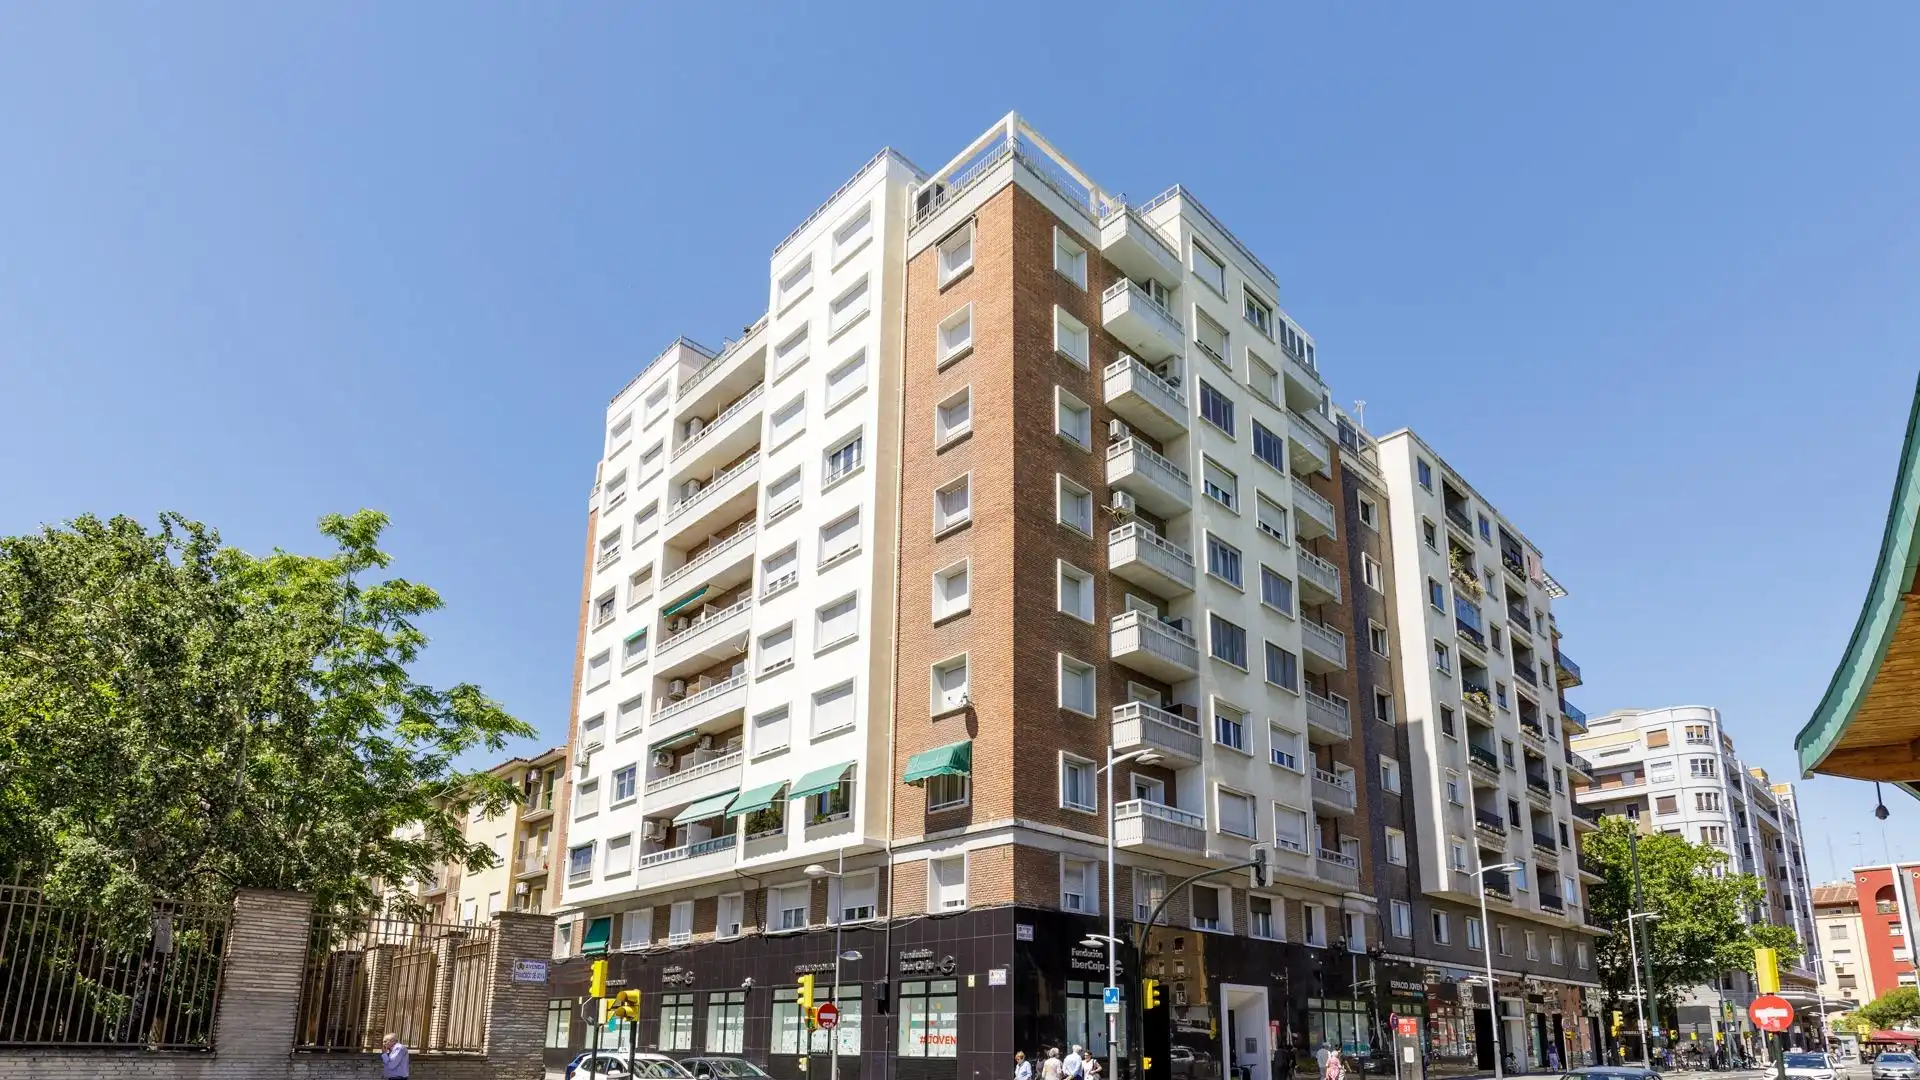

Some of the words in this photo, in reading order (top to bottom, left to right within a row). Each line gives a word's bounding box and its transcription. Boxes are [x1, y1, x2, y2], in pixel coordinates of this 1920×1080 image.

[1071, 947, 1103, 958] Fundación
[1390, 980, 1408, 988] ESPACIO
[1409, 982, 1422, 990] JOVEN
